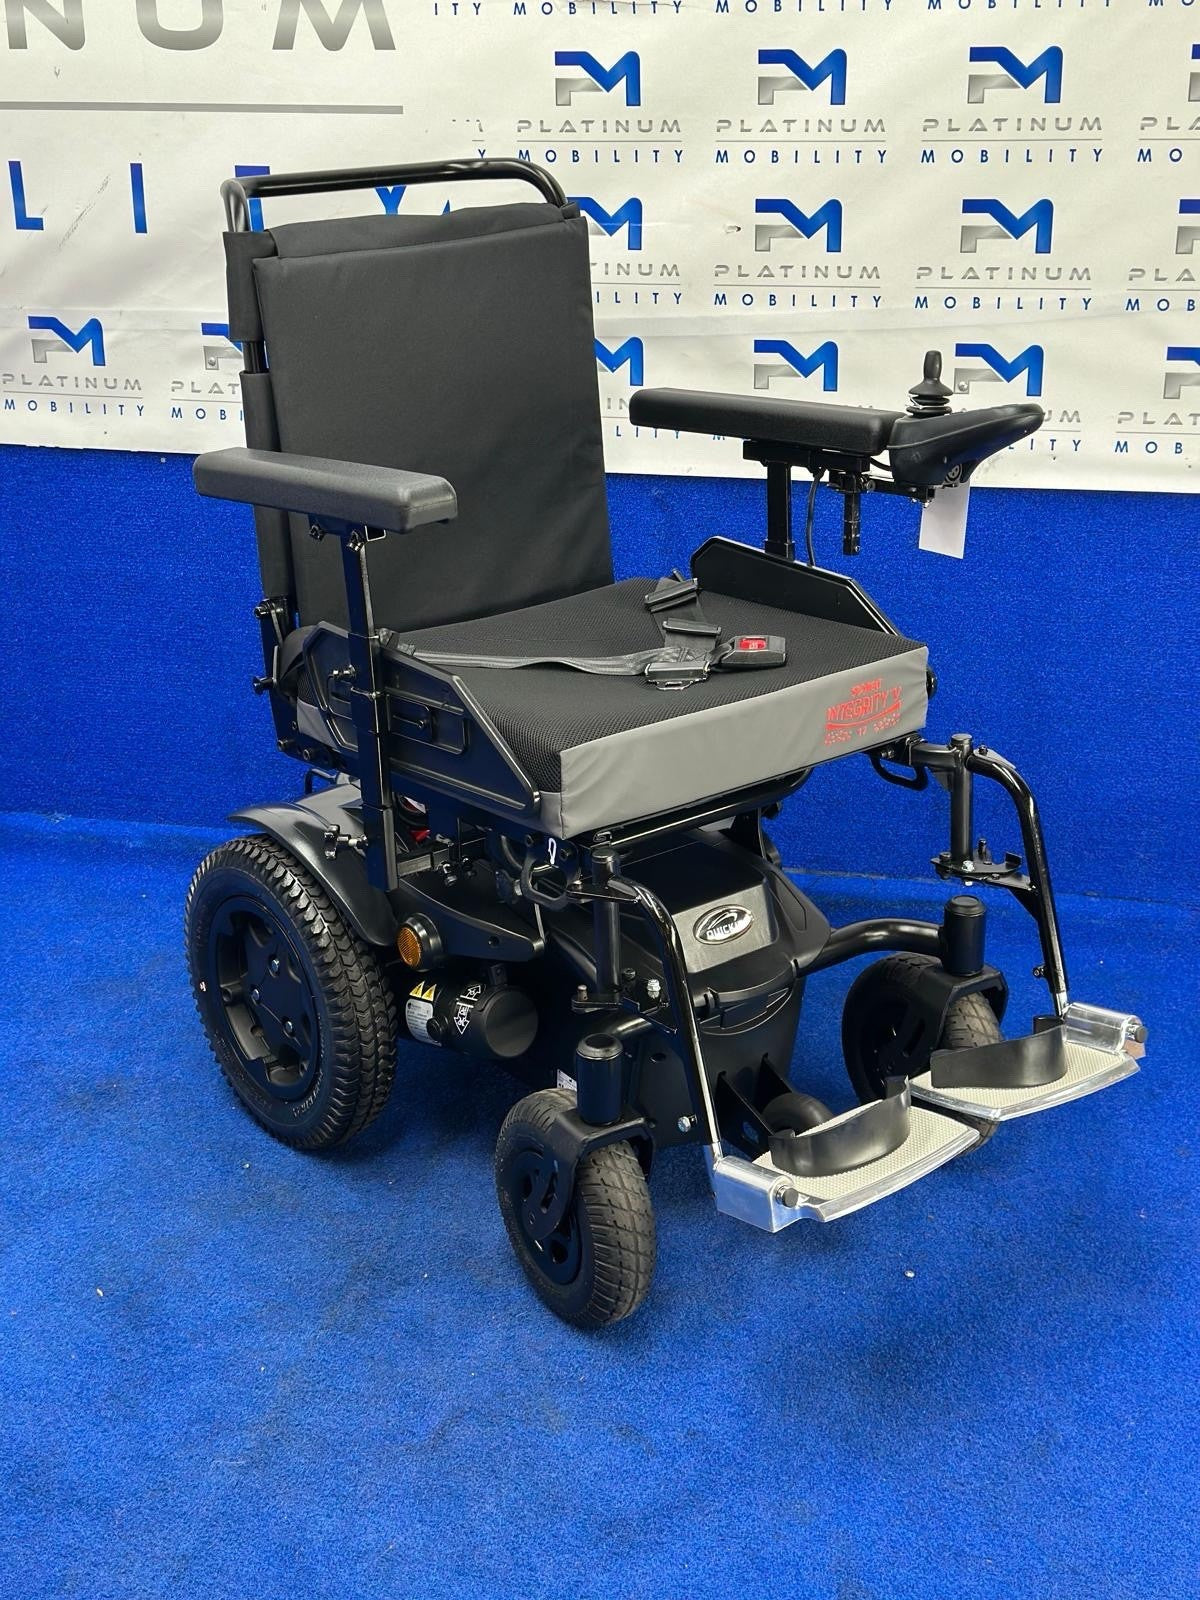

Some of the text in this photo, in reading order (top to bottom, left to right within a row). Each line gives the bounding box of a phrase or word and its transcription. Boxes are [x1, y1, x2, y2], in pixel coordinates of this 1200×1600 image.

[514, 0, 681, 15] MOBILITY
[716, 0, 891, 13] MOBILITY
[518, 120, 680, 133] PLATINUM
[717, 119, 885, 132] PLATINUM
[923, 117, 1102, 132] PLATINUM
[519, 150, 683, 163] MOBILITY
[716, 150, 886, 163] MOBILITY
[921, 149, 1102, 163] MOBILITY
[590, 262, 680, 277] INUM
[715, 265, 880, 279] PLATINUM
[917, 267, 1091, 280] PLATINUM
[715, 294, 881, 307] MOBILITY
[915, 296, 1091, 310] MOBILITY
[2, 373, 141, 392] PLATINUM
[5, 399, 144, 416] MOBILITY
